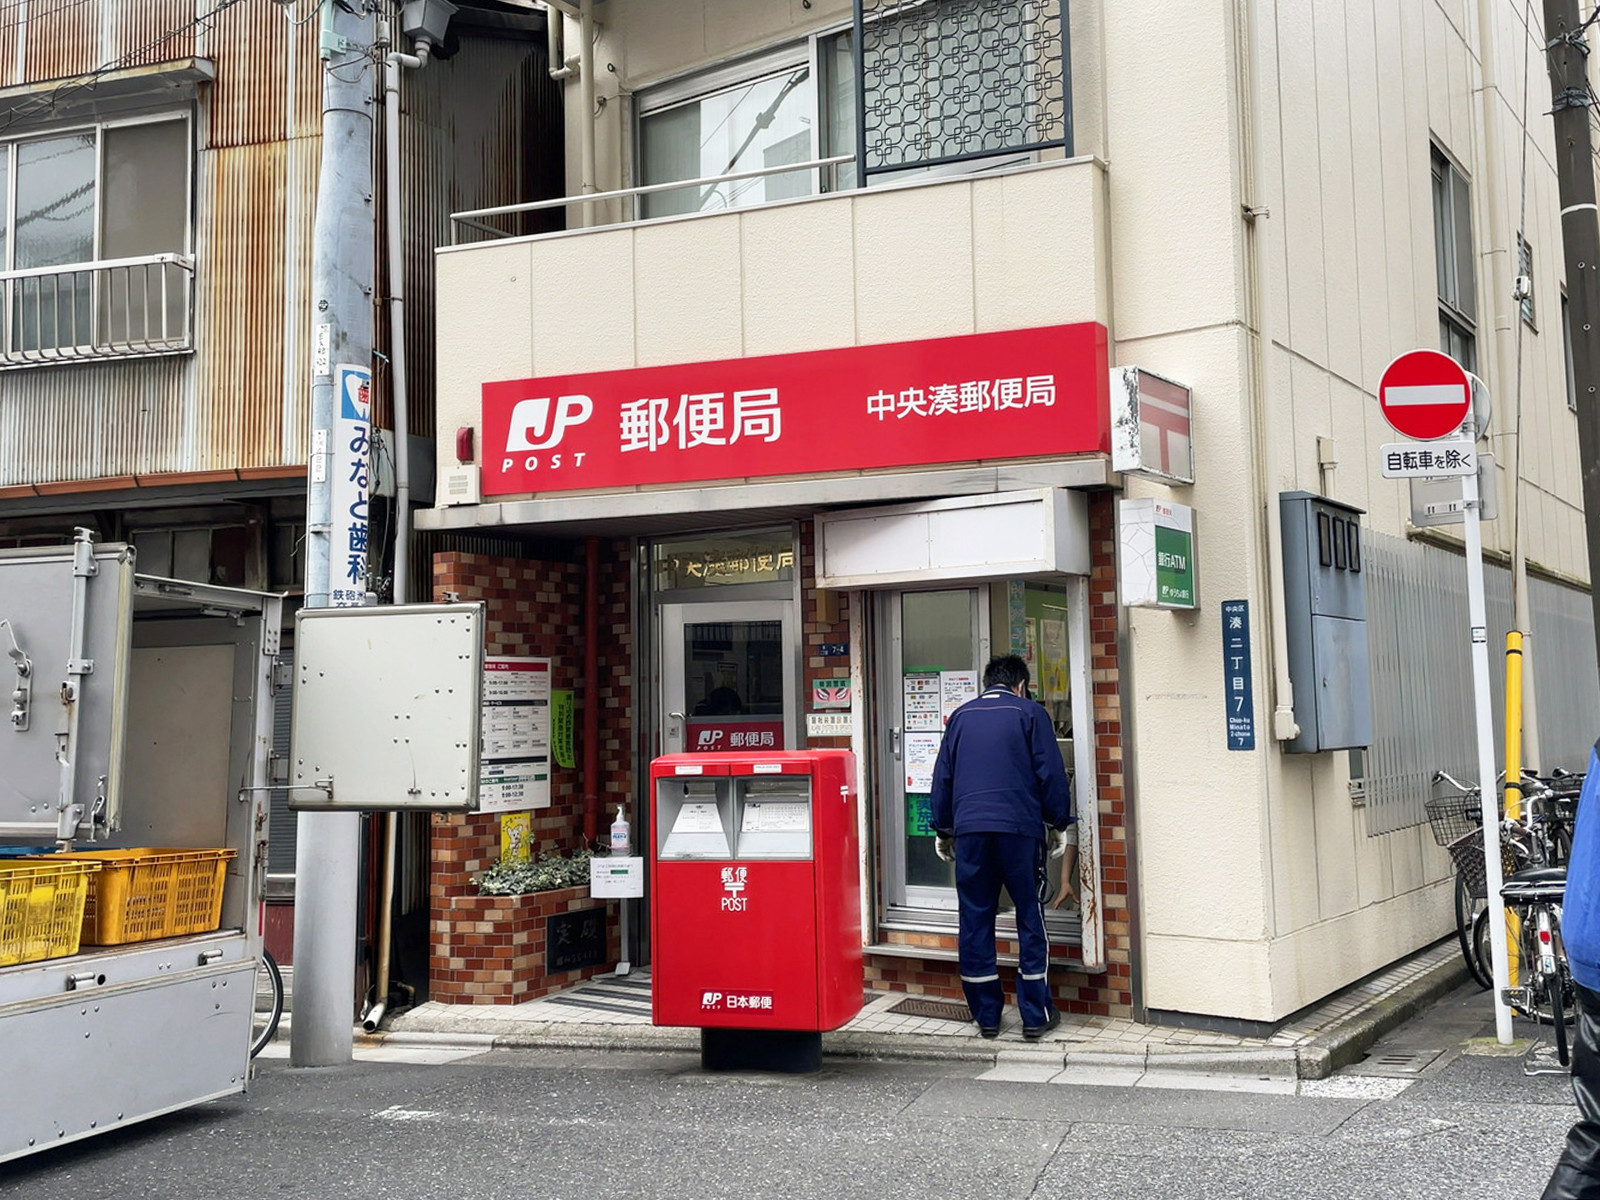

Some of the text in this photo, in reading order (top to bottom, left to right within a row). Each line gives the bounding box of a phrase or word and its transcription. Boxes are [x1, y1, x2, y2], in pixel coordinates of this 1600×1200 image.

[866, 374, 1056, 422] 中央湊郵便局
[618, 387, 782, 453] 郵便局
[501, 452, 586, 473] POST
[1387, 450, 1472, 471] 自転車を除く
[730, 731, 775, 747] 郵便局
[1237, 737, 1244, 746] 7
[720, 866, 748, 883] 郵便
[721, 897, 748, 912] POST
[726, 995, 773, 1009] 日本郵便
